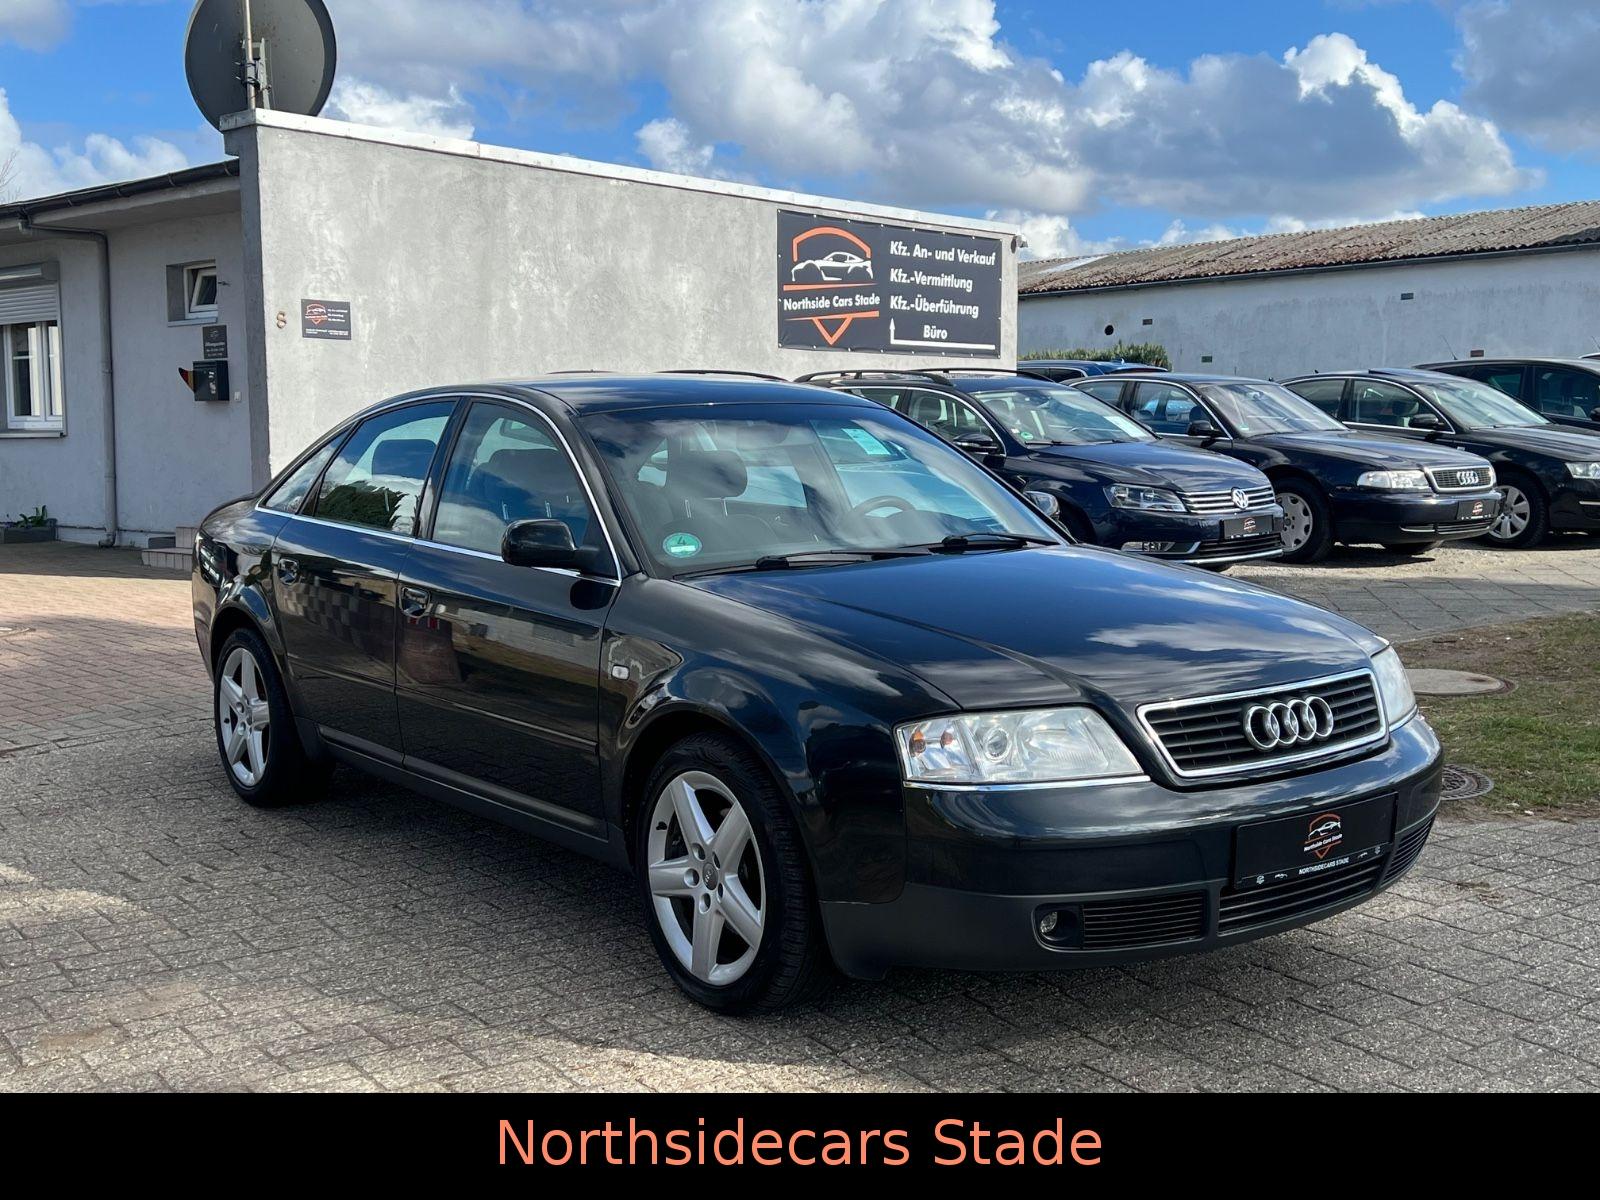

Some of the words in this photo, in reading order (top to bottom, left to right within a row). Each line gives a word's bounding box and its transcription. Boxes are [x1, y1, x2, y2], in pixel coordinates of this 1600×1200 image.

[890, 241, 911, 256] Kfz.
[913, 244, 933, 258] An-
[935, 246, 955, 260] und
[957, 249, 996, 266] Verkauf
[890, 268, 973, 292] Kfz.-Vermittlung
[783, 296, 831, 311] Northside
[832, 295, 853, 308] Cars
[855, 293, 881, 306] Stade
[890, 294, 979, 319] Kfz.-Überführung
[923, 325, 948, 340] Büro
[677, 535, 686, 546] 4
